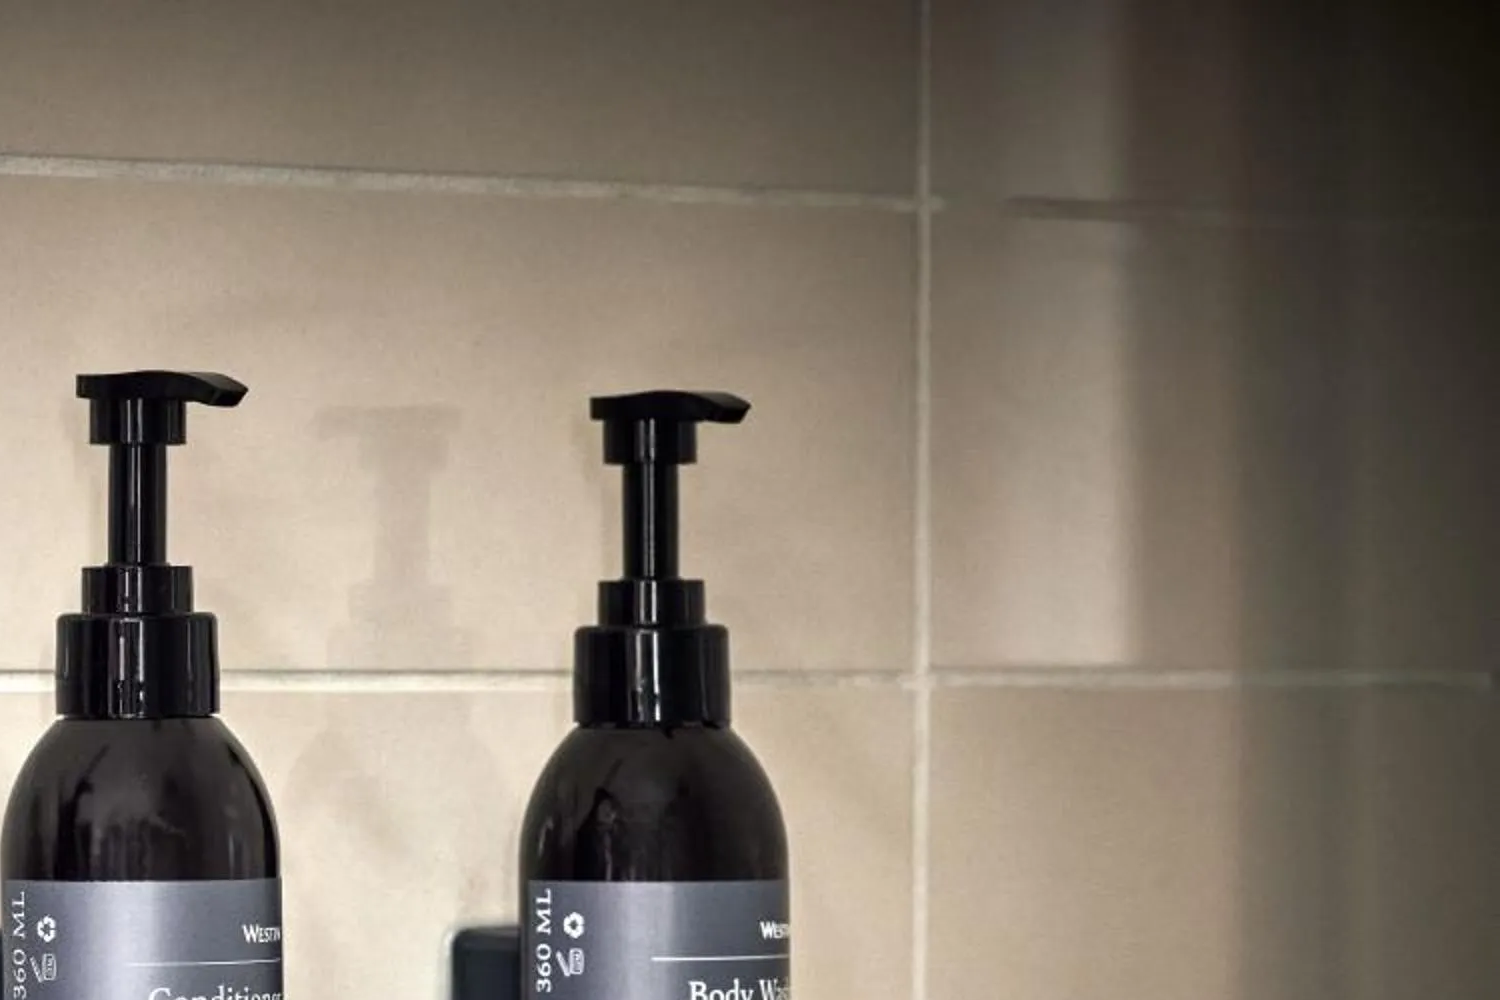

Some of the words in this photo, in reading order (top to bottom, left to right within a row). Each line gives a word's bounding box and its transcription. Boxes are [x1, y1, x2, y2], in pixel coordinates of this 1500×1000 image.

[12, 891, 25, 939] ML
[536, 887, 551, 935] ML
[12, 949, 27, 1000] 360
[536, 943, 551, 993] 360
